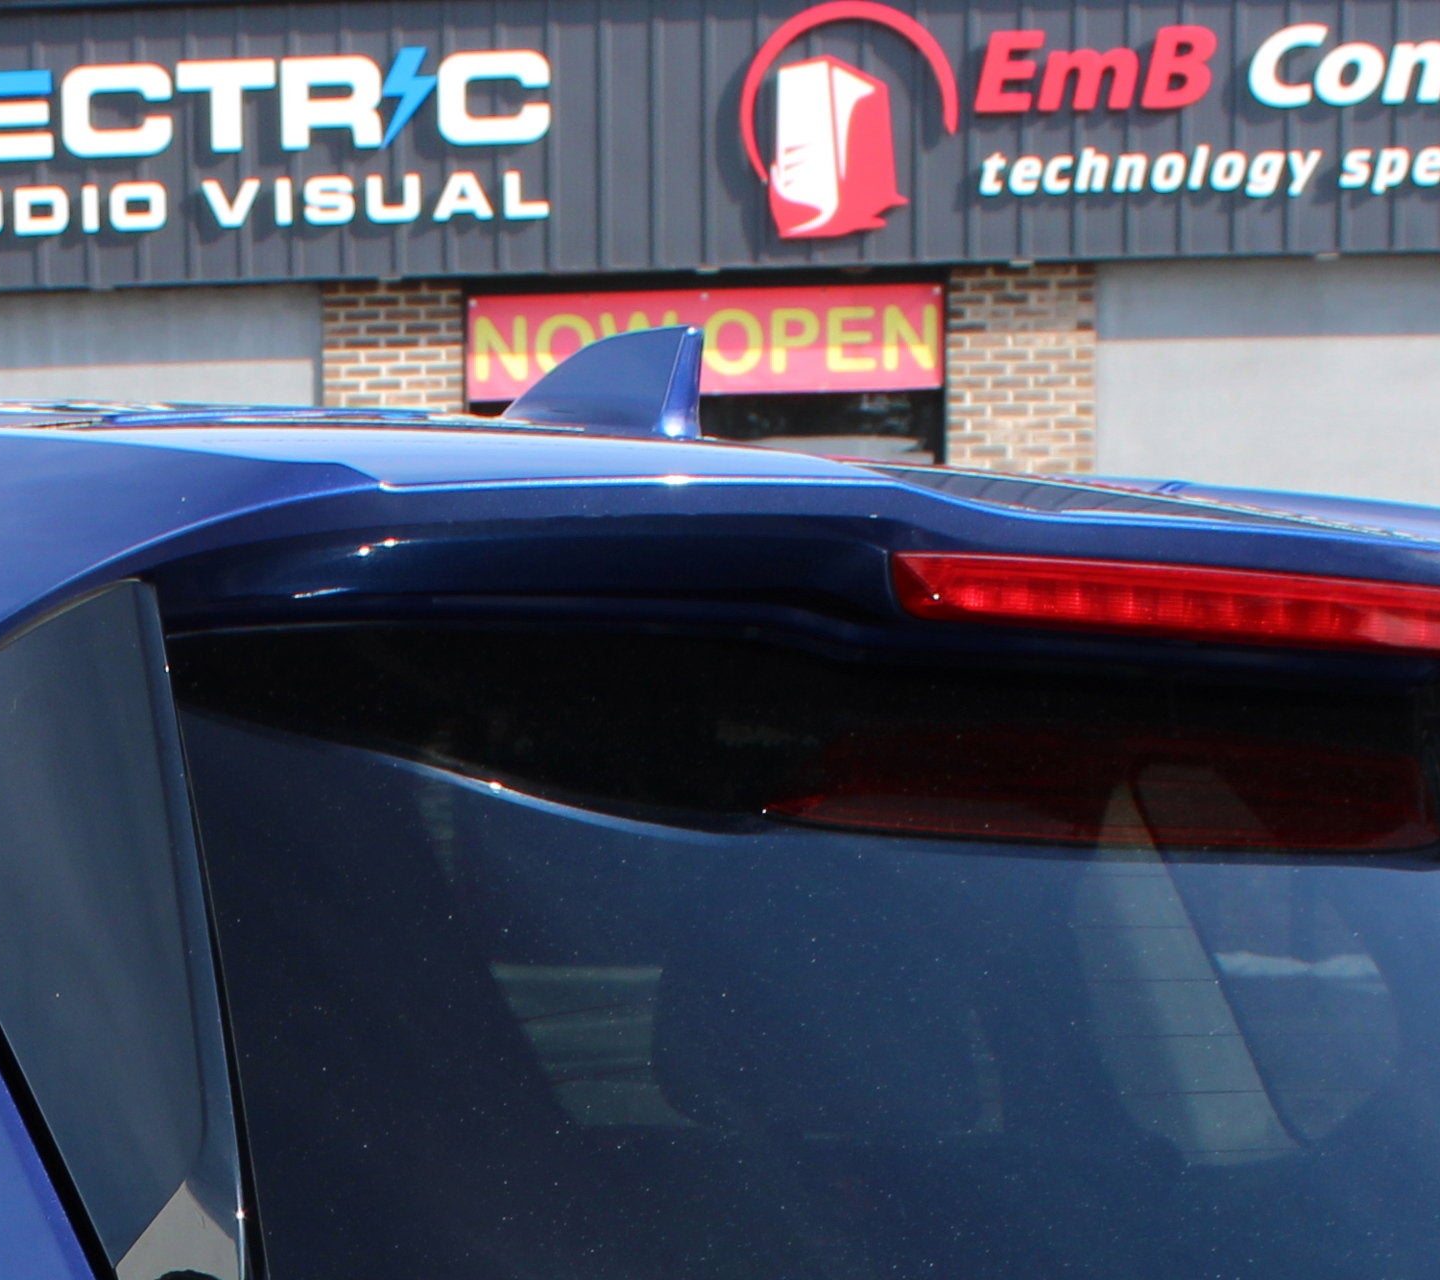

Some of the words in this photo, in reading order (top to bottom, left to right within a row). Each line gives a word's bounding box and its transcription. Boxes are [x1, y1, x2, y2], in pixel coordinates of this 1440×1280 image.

[974, 27, 1218, 114] EmB
[201, 170, 550, 228] VISUAL
[979, 142, 1322, 197] technology
[703, 305, 938, 375] OPEN
